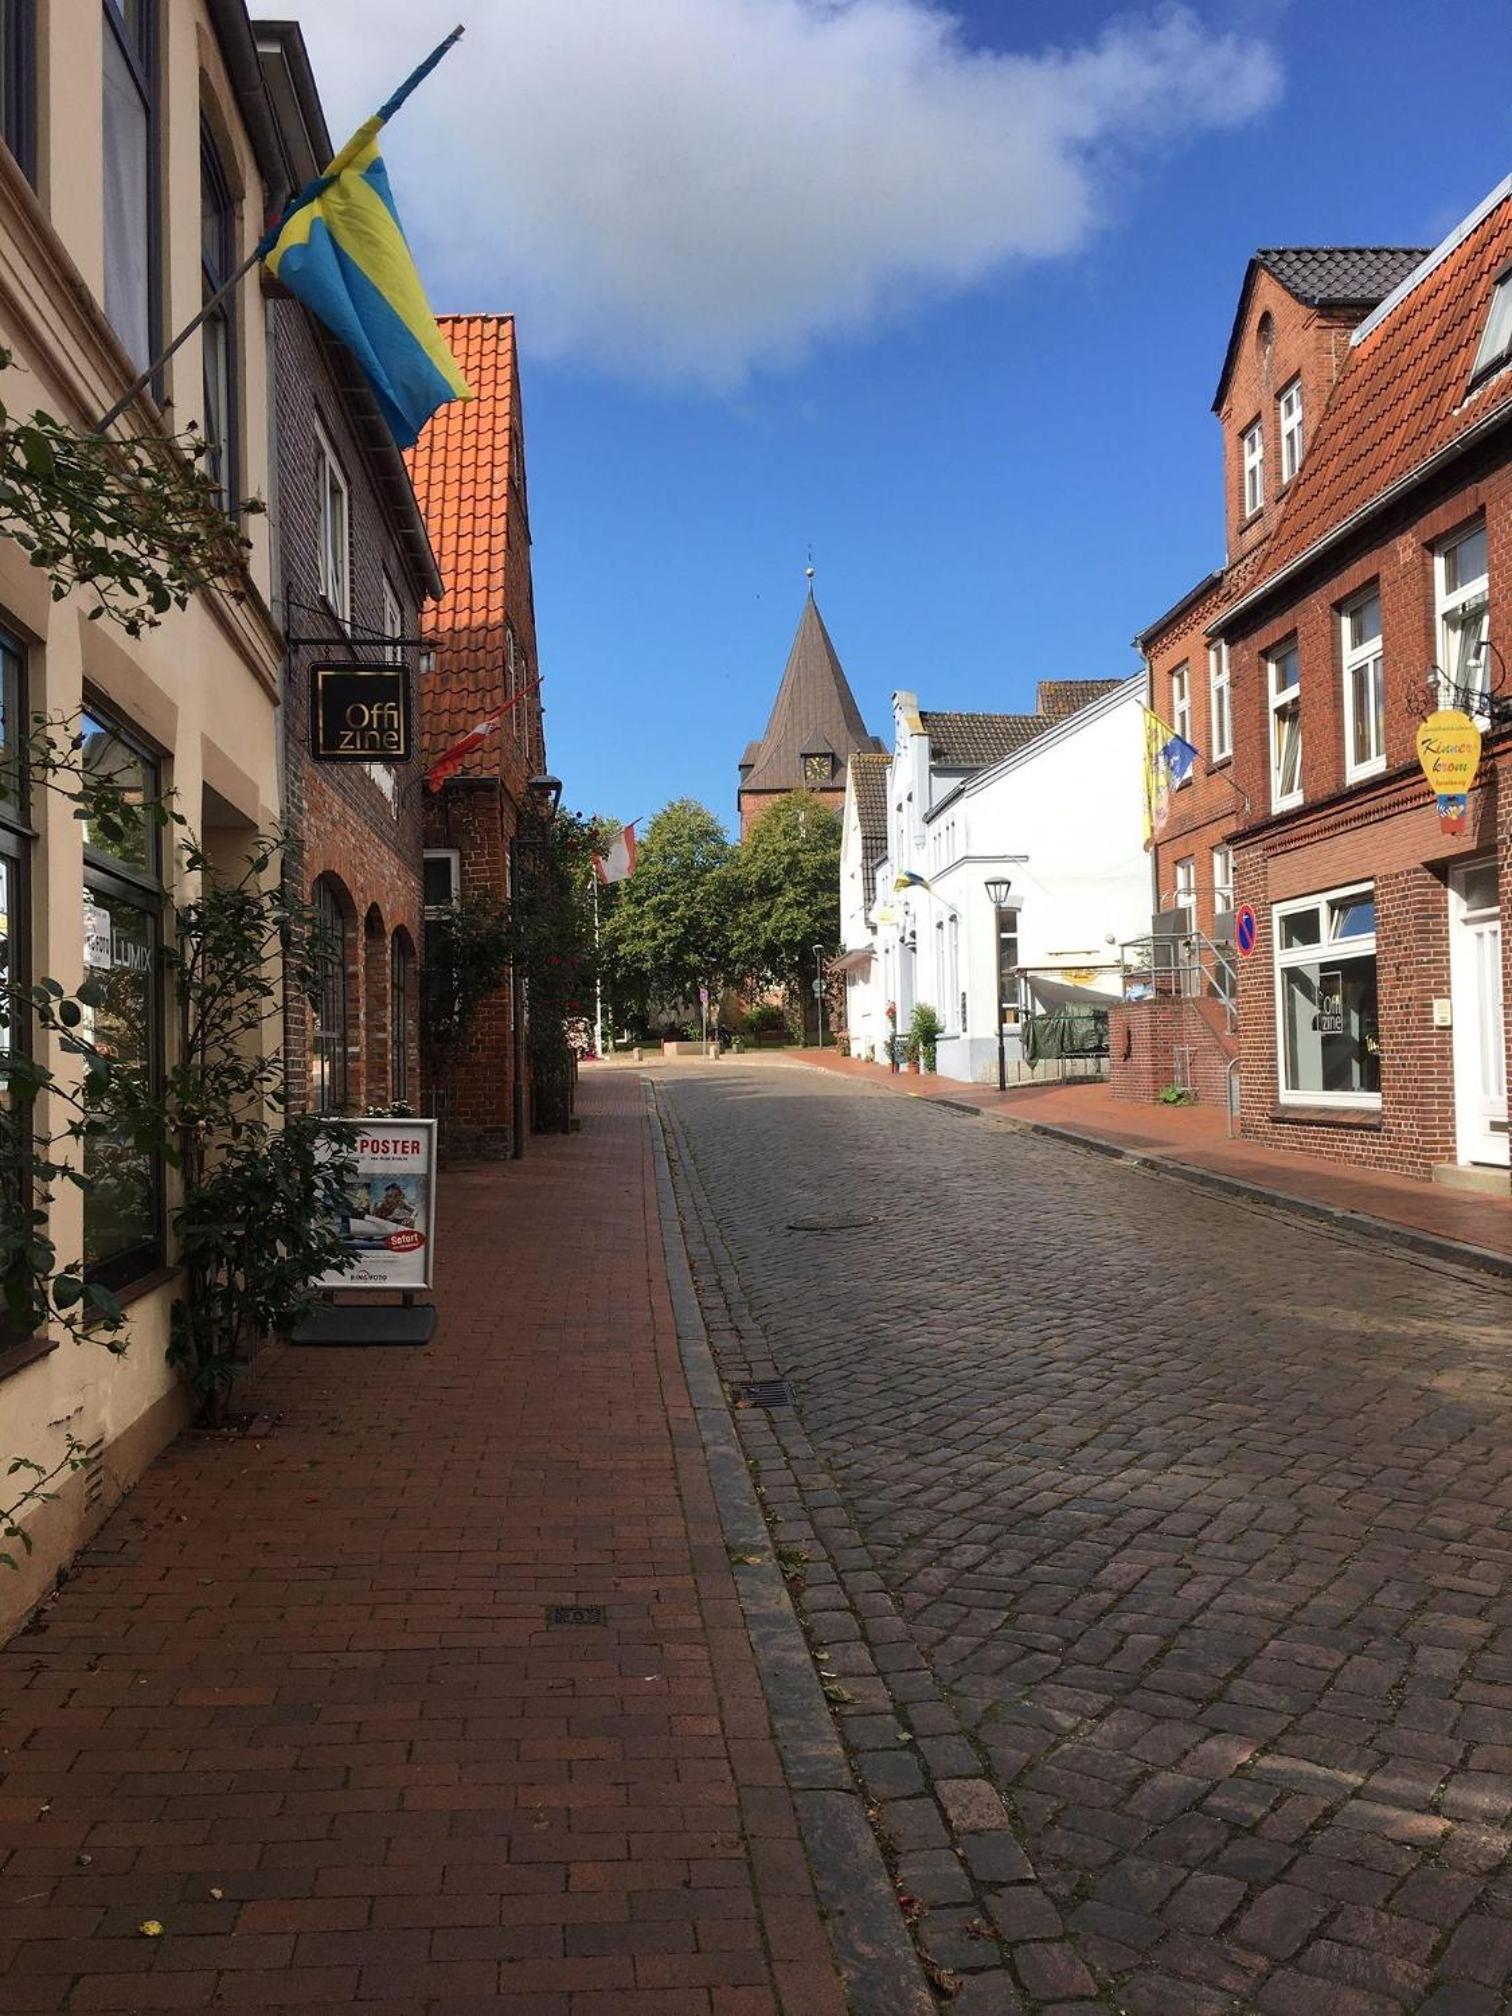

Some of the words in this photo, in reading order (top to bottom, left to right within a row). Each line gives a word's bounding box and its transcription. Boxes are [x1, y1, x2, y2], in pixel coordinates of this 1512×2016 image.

[346, 702, 398, 729] Offi
[339, 731, 398, 749] zine
[360, 1139, 420, 1154] POSTER
